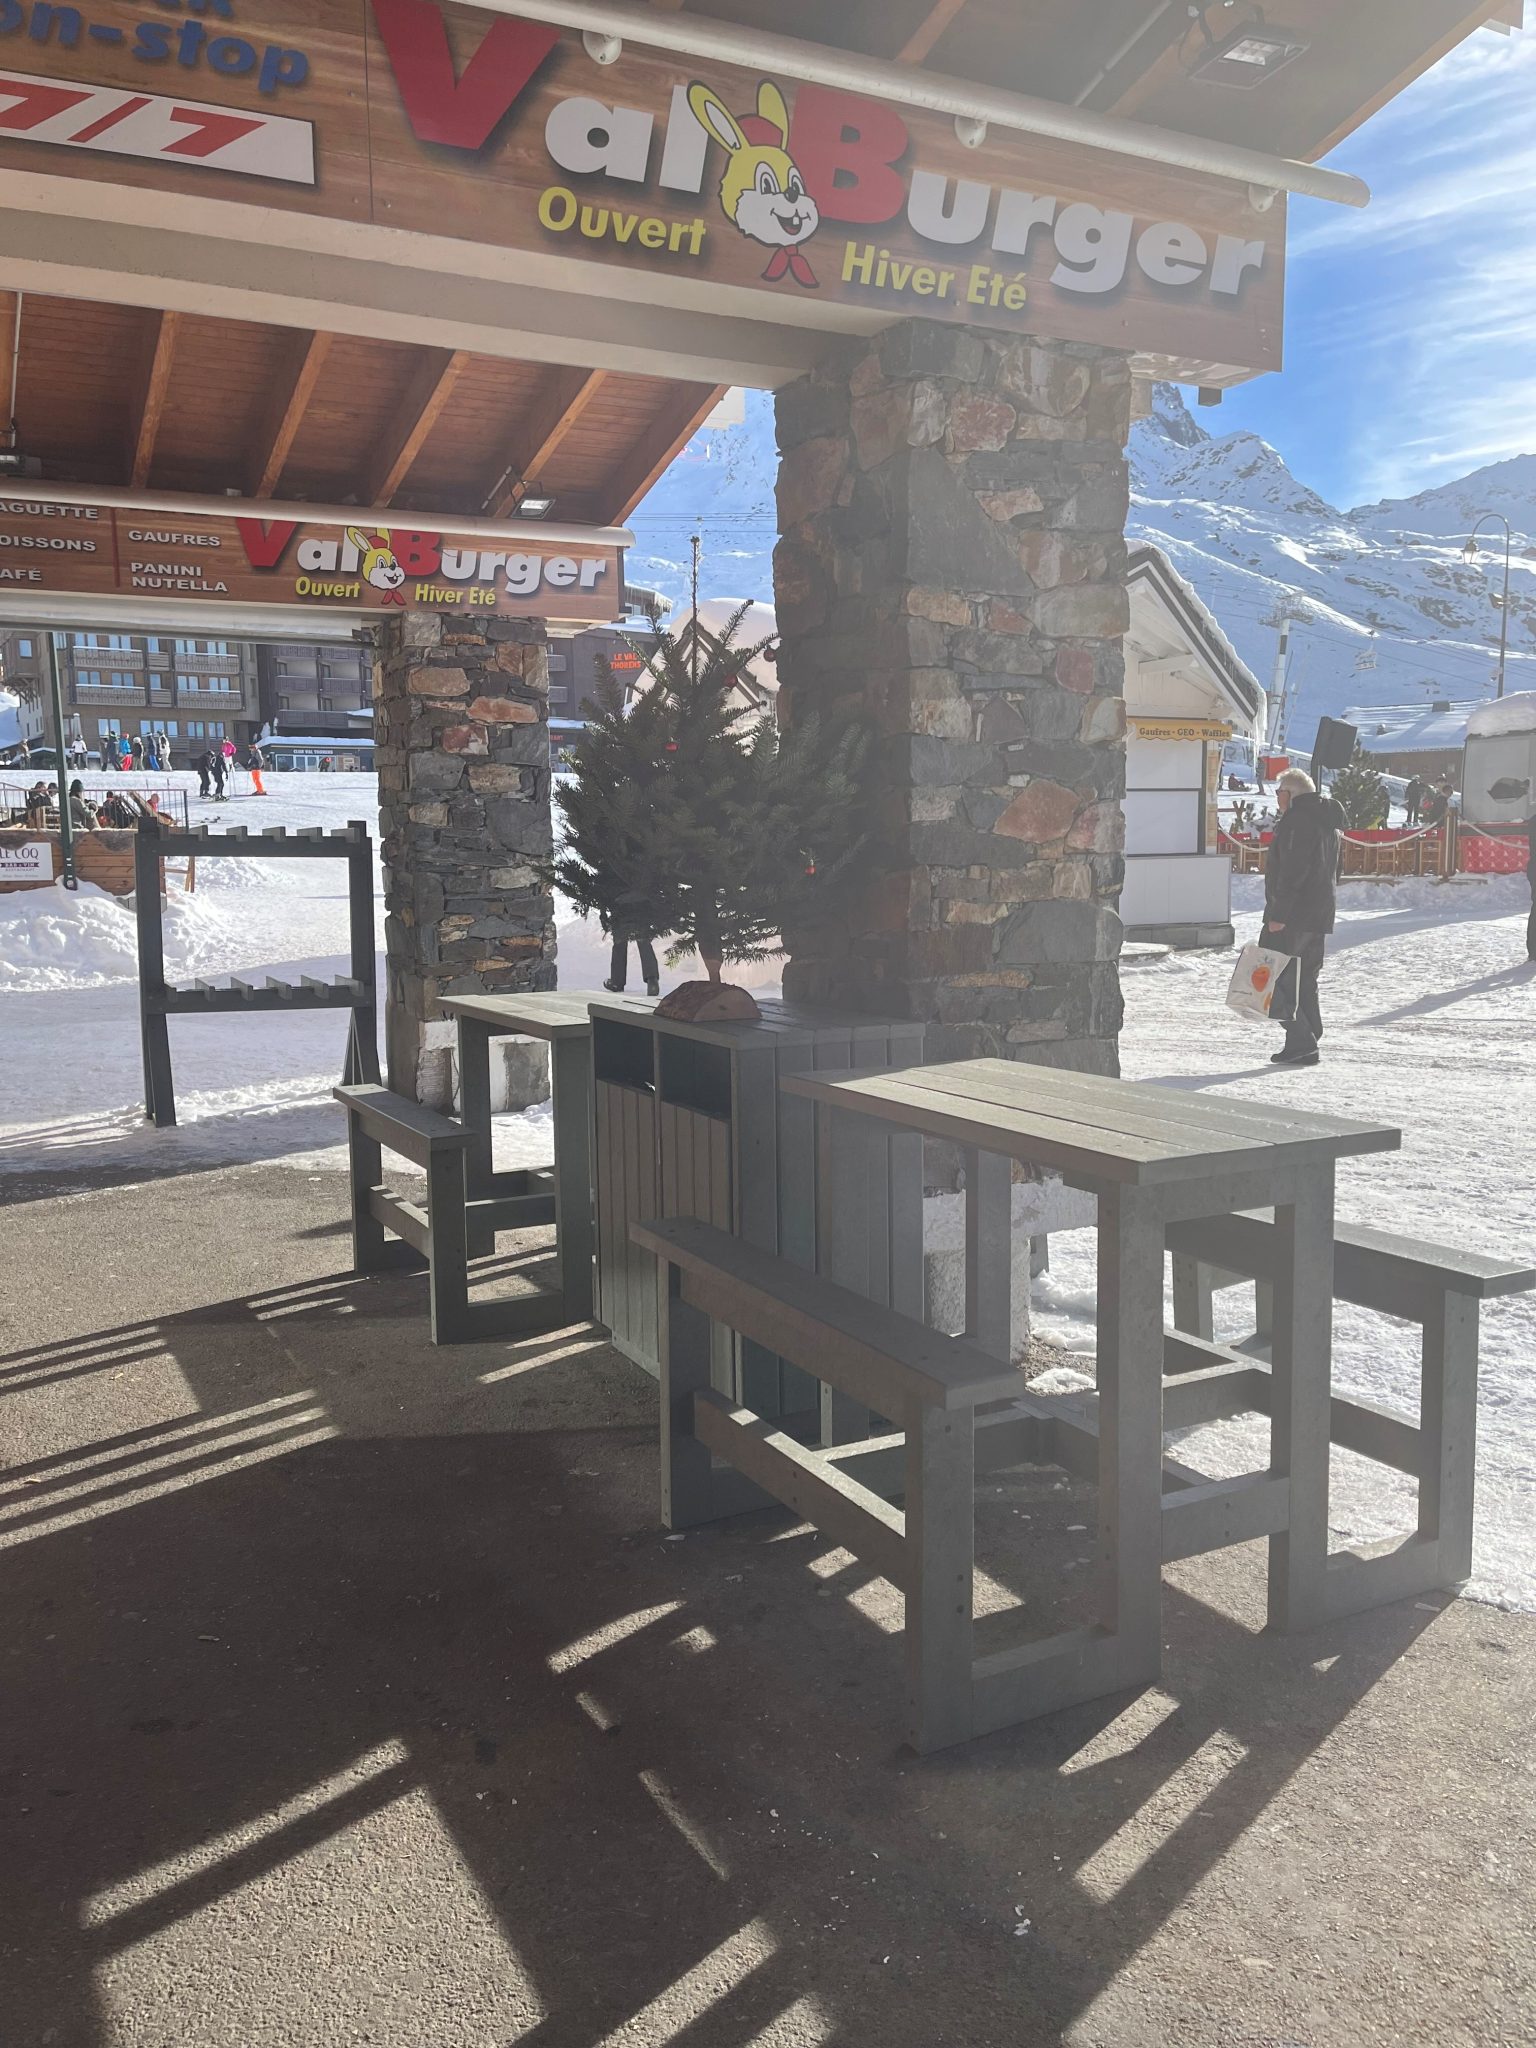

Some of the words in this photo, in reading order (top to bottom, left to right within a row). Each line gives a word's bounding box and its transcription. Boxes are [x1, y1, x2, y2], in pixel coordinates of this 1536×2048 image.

[372, 0, 709, 193] Val
[788, 84, 1265, 295] Burger
[538, 186, 706, 255] Ouvert
[842, 241, 955, 299] Hiver
[966, 264, 1027, 311] Eté
[128, 530, 221, 547] GAUFRES
[236, 518, 360, 572] Val
[391, 528, 606, 595] Burger
[131, 562, 202, 577] PANINI
[132, 576, 228, 592] NUTELLA
[295, 576, 360, 598] Ouvert
[414, 586, 464, 604] Hiver
[469, 586, 496, 606] Eté
[610, 660, 641, 669] THORENS
[614, 653, 623, 661] LE
[623, 652, 638, 661] VAL
[1201, 728, 1230, 737] Waffles
[15, 847, 39, 860] COQ
